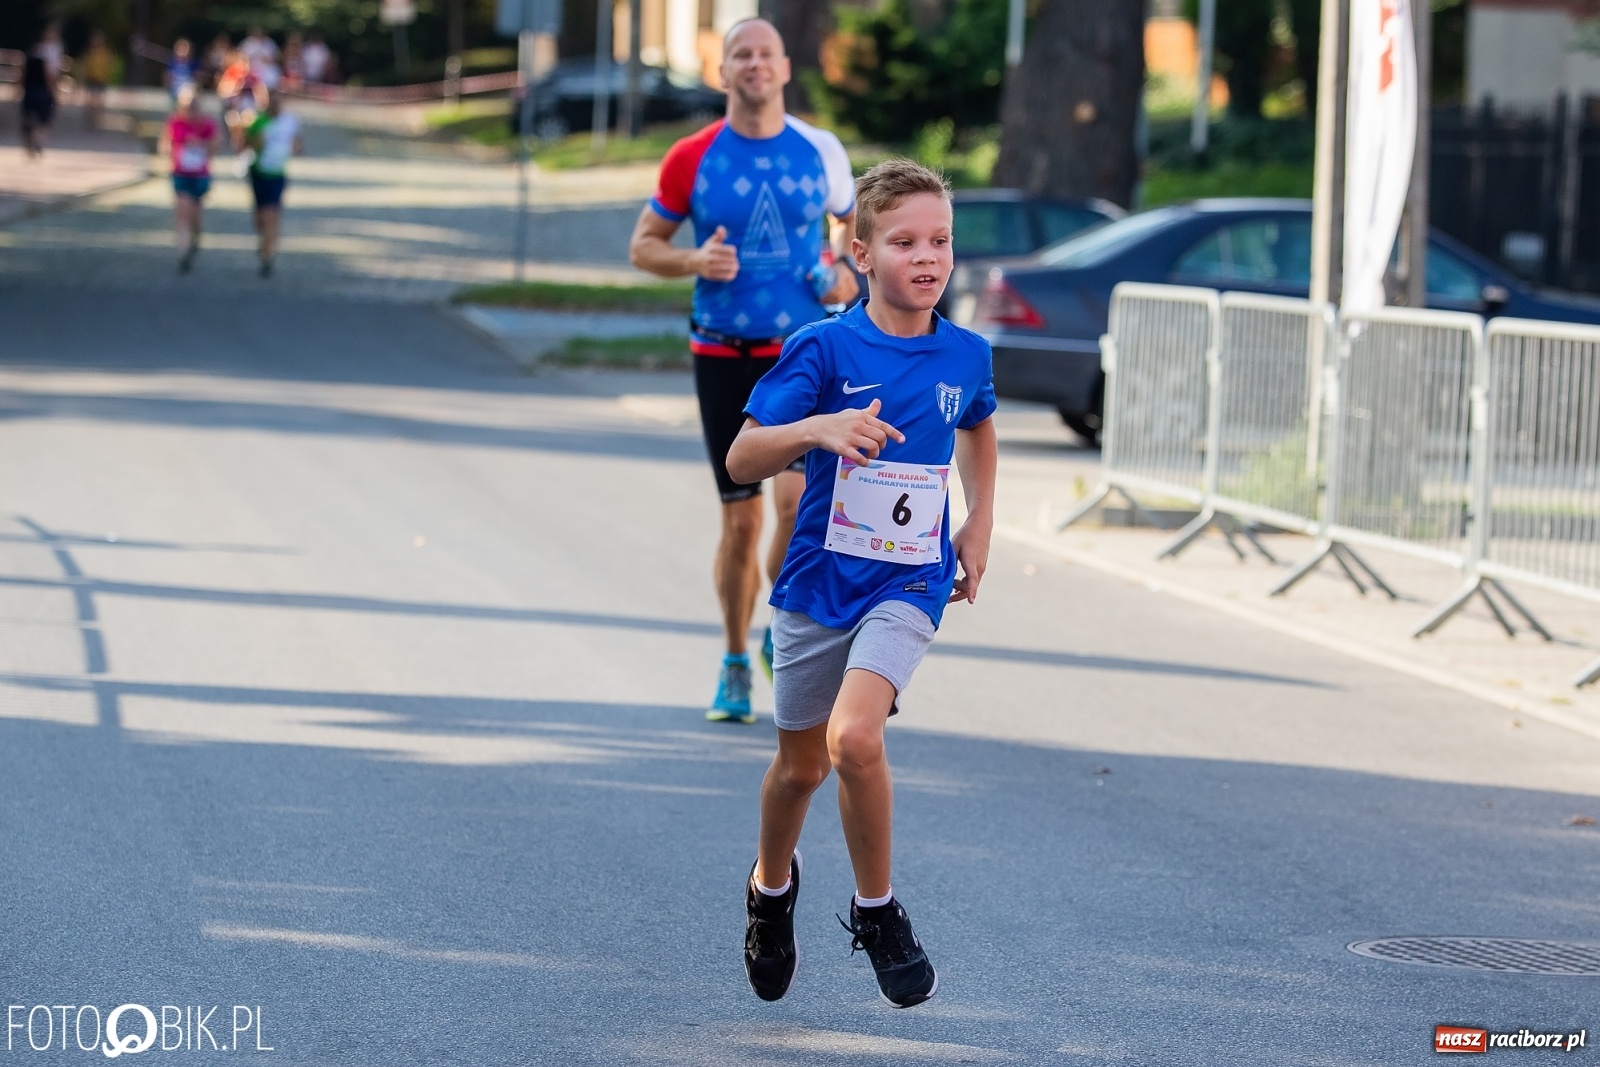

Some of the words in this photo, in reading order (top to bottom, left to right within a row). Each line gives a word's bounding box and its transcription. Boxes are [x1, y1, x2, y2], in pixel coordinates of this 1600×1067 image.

[877, 471, 896, 479] MINI
[898, 473, 929, 482] RAFAKO
[892, 492, 912, 526] 6
